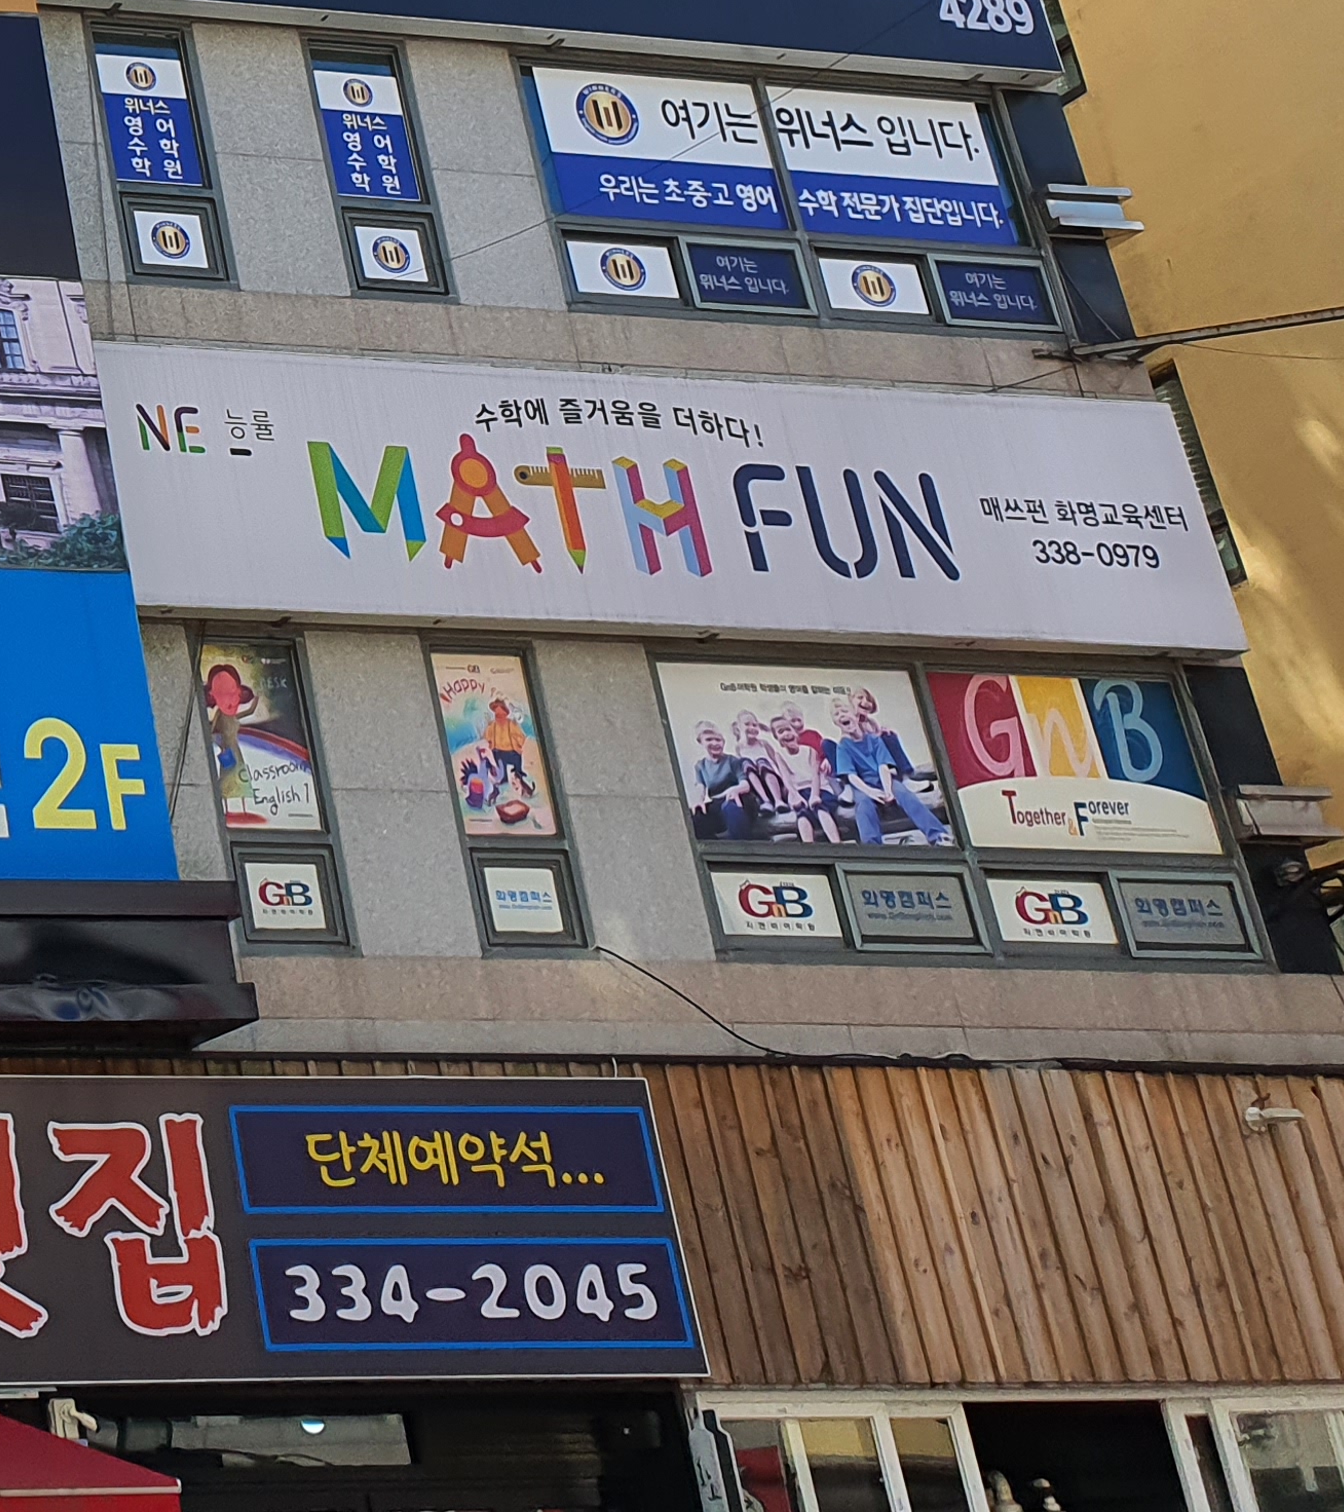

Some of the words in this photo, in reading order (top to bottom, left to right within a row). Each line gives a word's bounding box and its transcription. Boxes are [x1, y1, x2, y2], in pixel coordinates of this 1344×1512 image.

[124, 97, 171, 116] 위너스
[342, 113, 388, 131] 위너스
[661, 99, 758, 144] 여기는
[775, 107, 874, 153] 위너스
[877, 115, 980, 162] 입니다.
[598, 173, 661, 205] 우리는
[735, 183, 779, 214] 영어
[840, 191, 902, 223] 전문가
[699, 272, 744, 292] 위너스
[716, 254, 758, 274] 여기는
[965, 271, 1007, 290] 여기는
[948, 289, 992, 308] 위너스
[135, 403, 207, 455] NE
[224, 407, 276, 442] 능률
[475, 397, 549, 434] 수학에
[558, 397, 663, 430] 즐거움을
[672, 406, 765, 449] 더하다!
[307, 432, 713, 578] MATH
[732, 462, 961, 582] FUN
[979, 495, 1050, 526] 매쓰펀
[1055, 498, 1190, 533] 화명교육센터
[1031, 538, 1161, 571] 338-0979
[22, 716, 147, 832] 2F
[253, 785, 301, 817] English
[1001, 790, 1066, 827] Together
[1073, 800, 1130, 837] Forever
[283, 1262, 659, 1324] 334-2045
